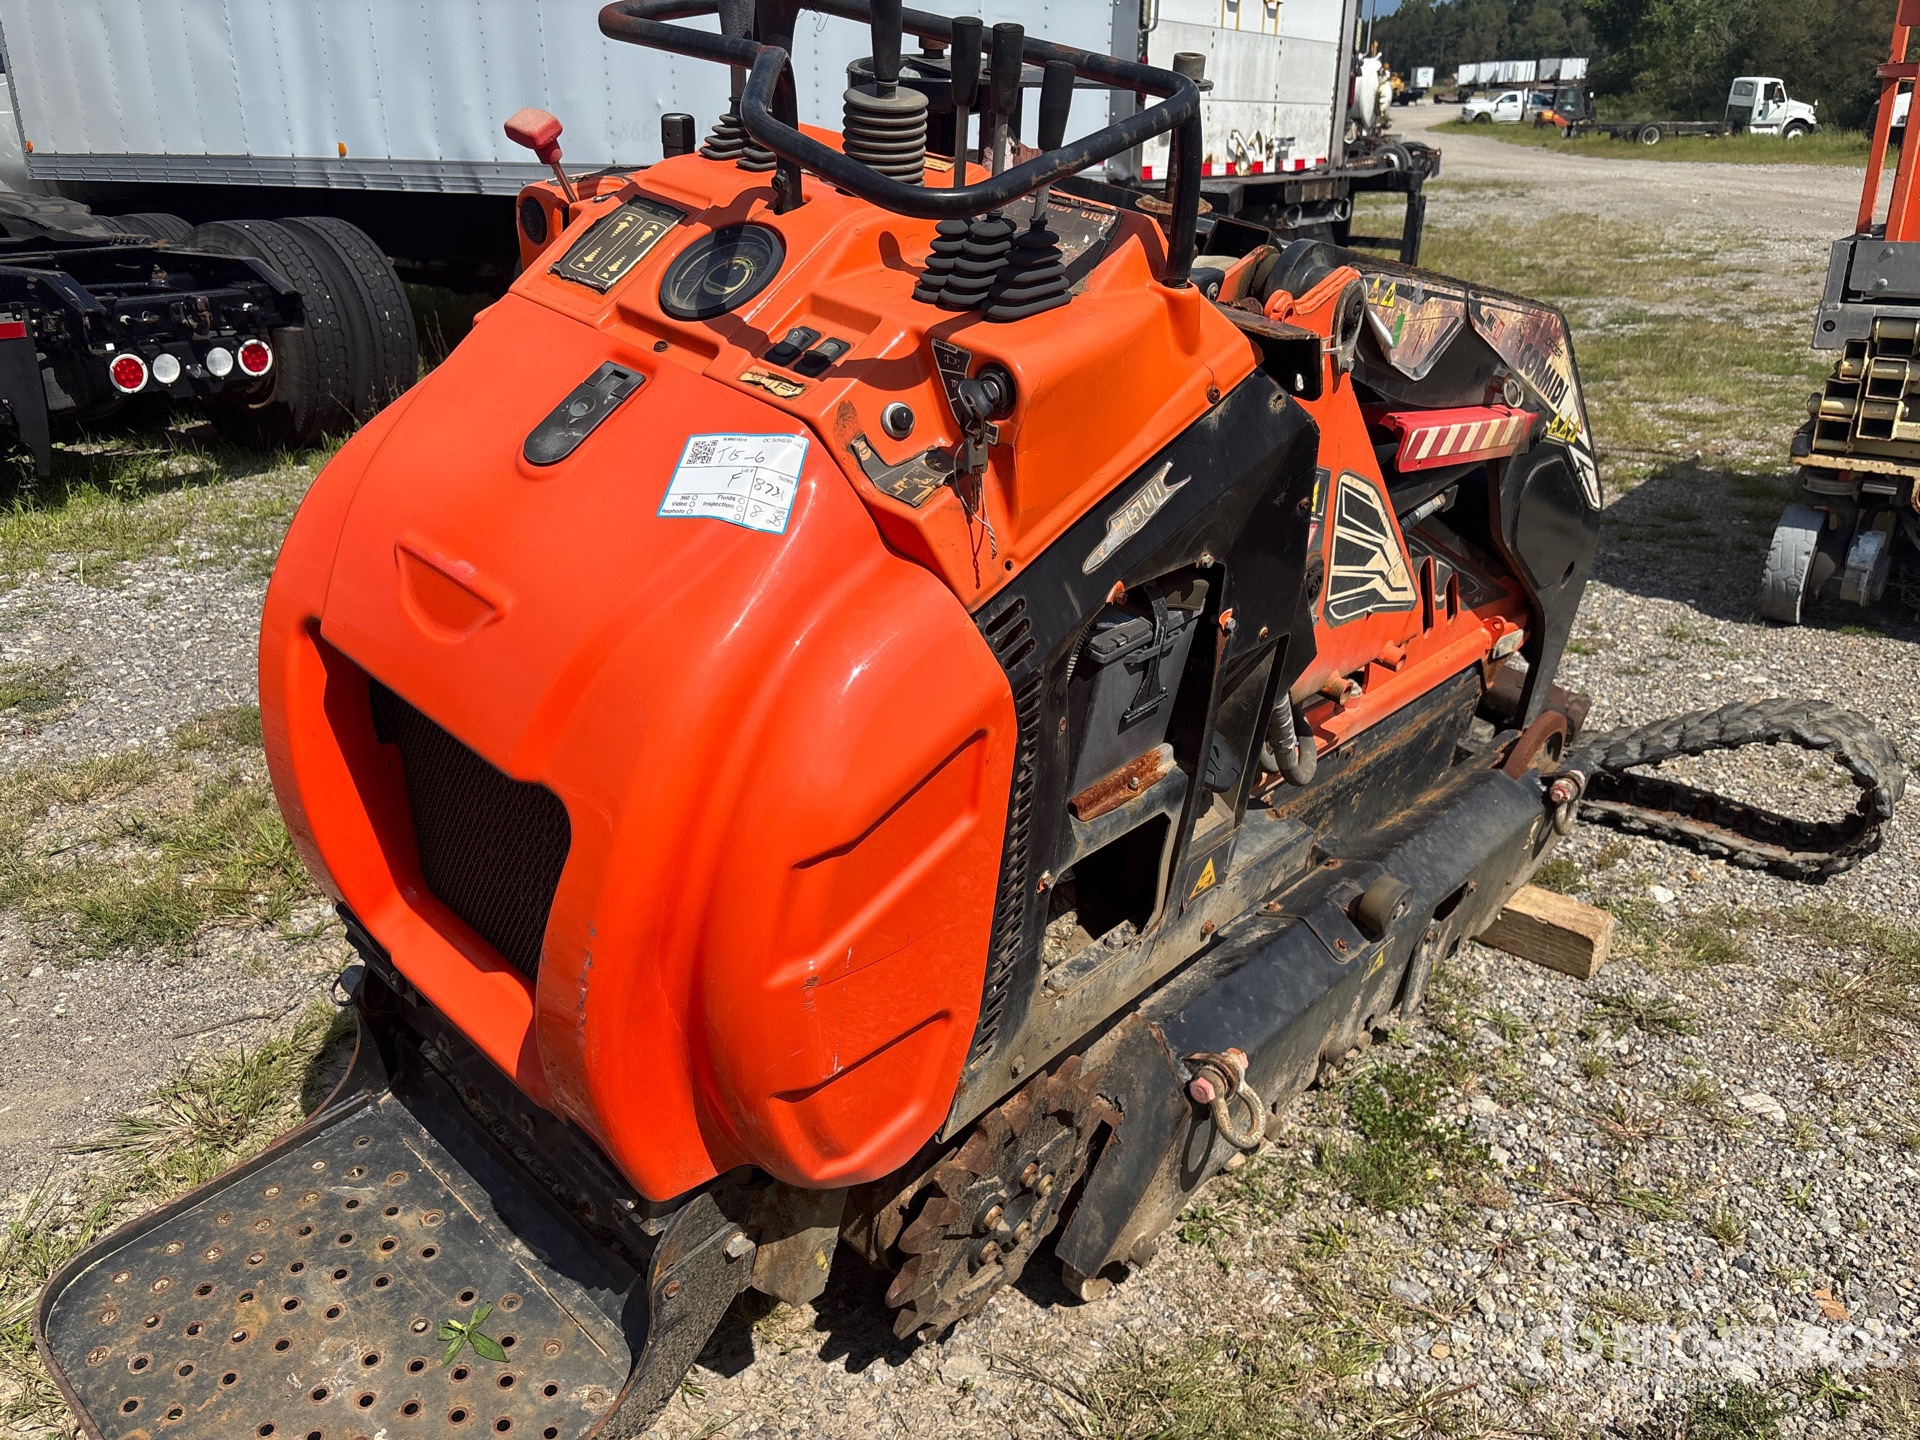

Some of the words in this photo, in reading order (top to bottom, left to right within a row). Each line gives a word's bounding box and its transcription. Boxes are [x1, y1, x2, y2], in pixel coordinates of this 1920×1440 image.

[1518, 342, 1569, 410] CORMIDI
[779, 475, 794, 485] Notes
[716, 494, 737, 502] Fluids
[702, 501, 735, 510] Inspection
